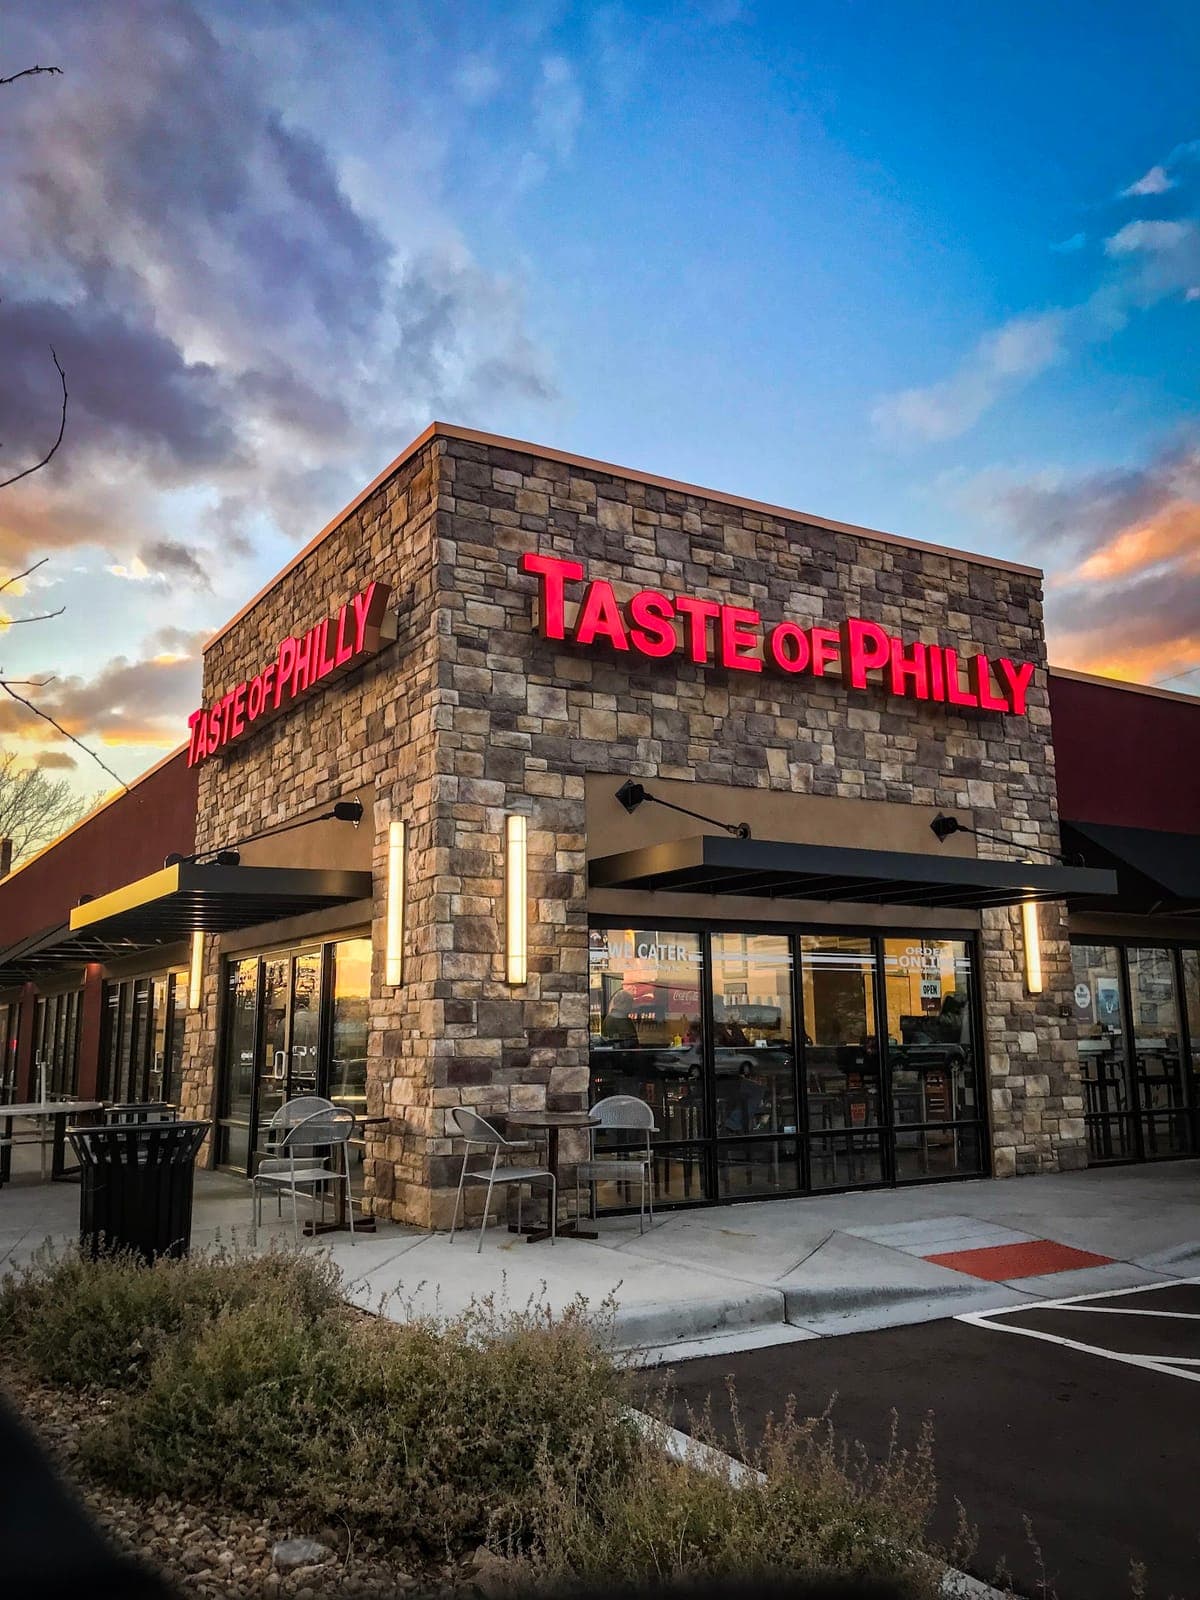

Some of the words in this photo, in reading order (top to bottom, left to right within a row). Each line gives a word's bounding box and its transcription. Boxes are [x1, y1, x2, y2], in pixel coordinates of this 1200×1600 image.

[520, 552, 762, 674] TASTE
[766, 621, 841, 677] OF
[845, 617, 1036, 716] PHILLY
[187, 681, 247, 768] TASTE
[248, 663, 277, 721] OF
[274, 580, 378, 710] PHILLY
[637, 943, 687, 961] CATER
[906, 947, 949, 956] ORDE
[900, 956, 955, 968] ONLI
[923, 985, 938, 995] OPEN
